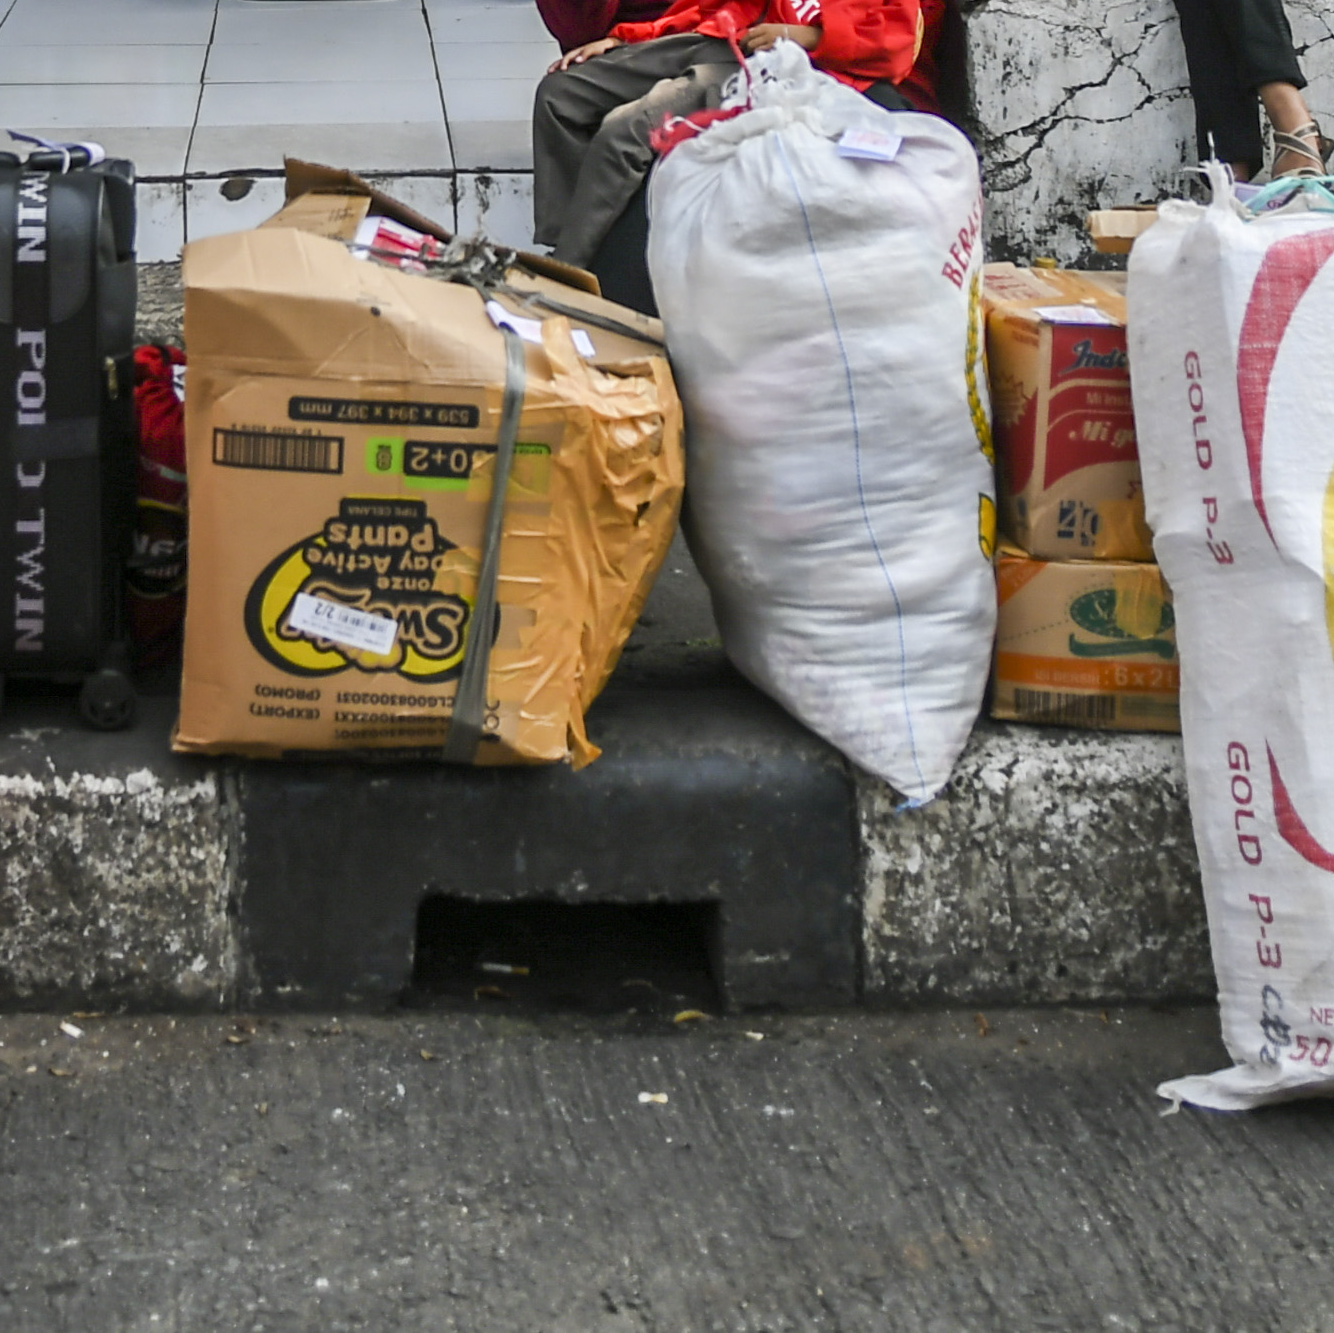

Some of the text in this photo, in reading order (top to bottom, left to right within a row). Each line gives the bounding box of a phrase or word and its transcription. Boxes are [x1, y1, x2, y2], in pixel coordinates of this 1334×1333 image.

[942, 196, 983, 291] BER
[1184, 350, 1234, 564] GOLD P-3
[328, 522, 436, 553] Pants
[307, 546, 390, 575] Active
[14, 520, 47, 654] TWIN
[375, 575, 446, 593] ronze
[313, 601, 335, 620] 2/2
[255, 683, 322, 701] (PROMO)
[249, 703, 321, 720] (EXPORT)
[1227, 741, 1263, 866] GOLD
[1248, 893, 1283, 969] P-3
[1289, 1035, 1333, 1067] 50
